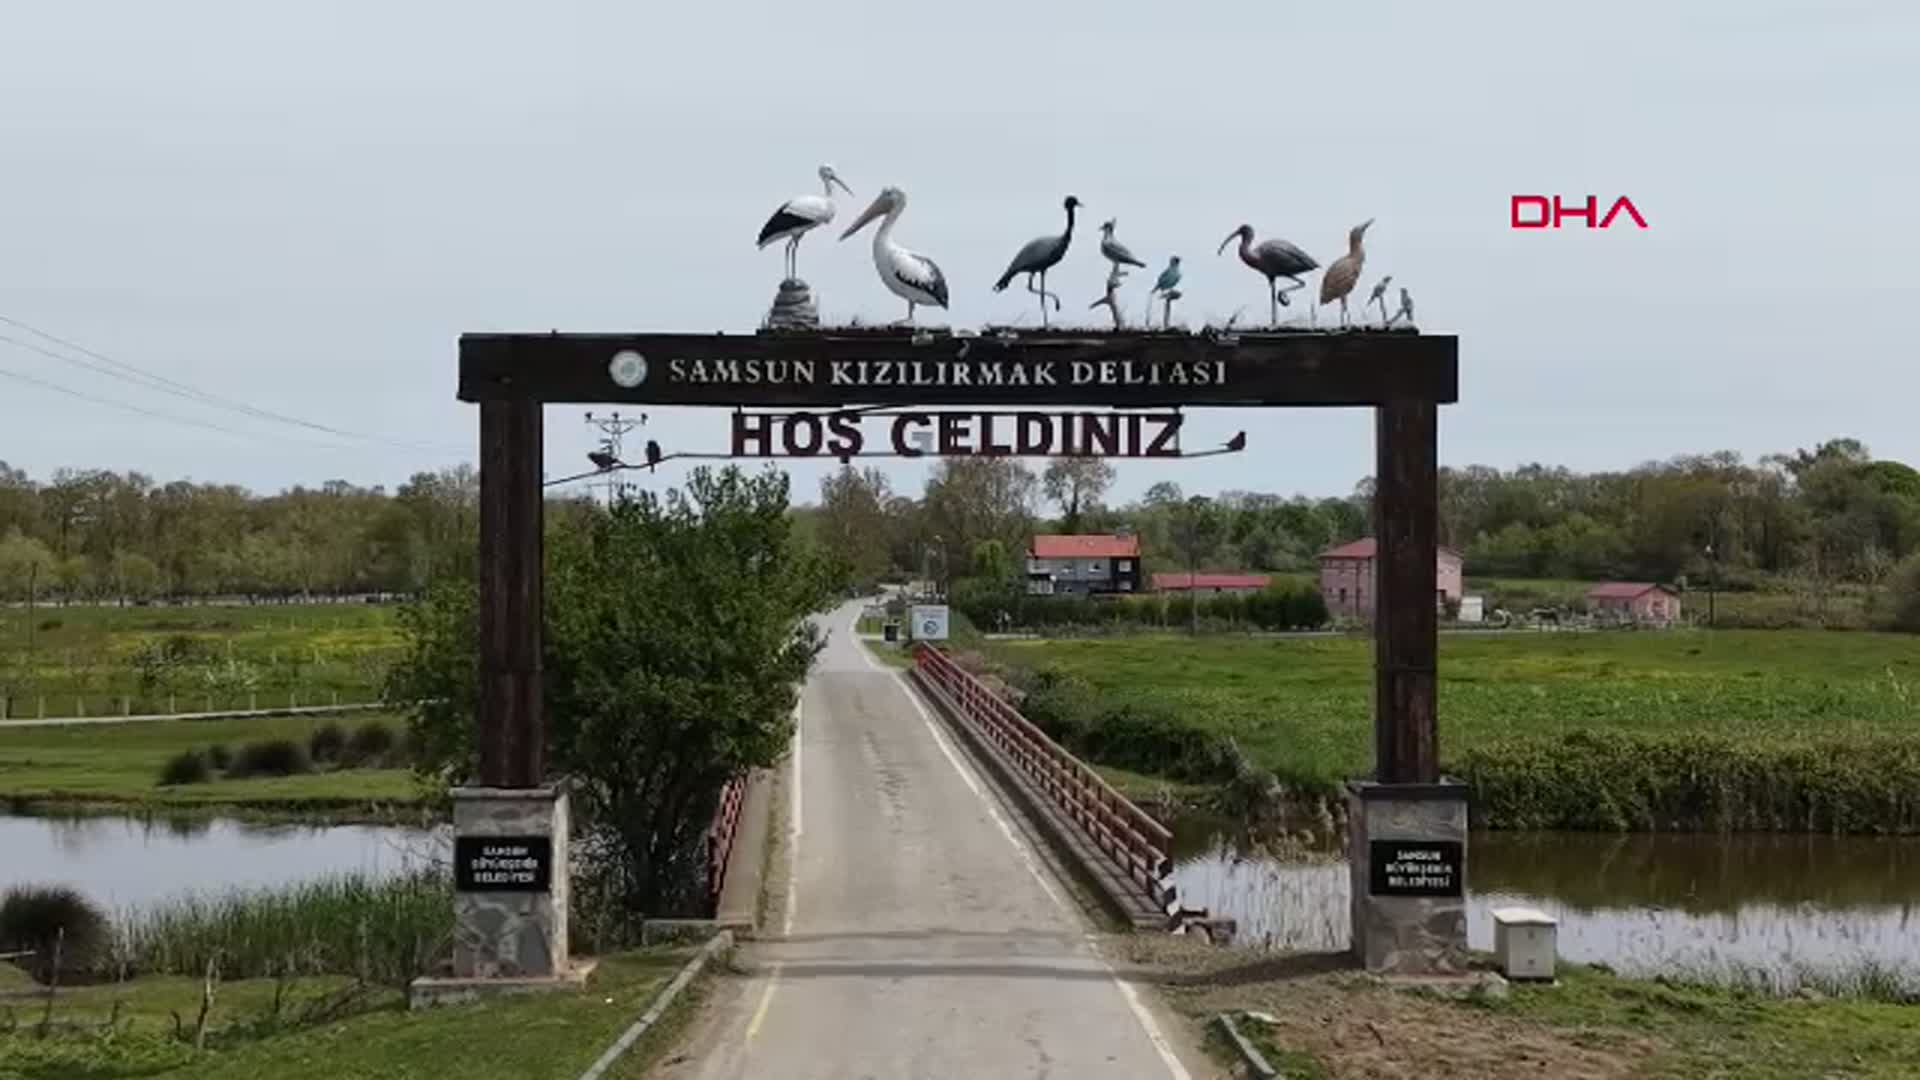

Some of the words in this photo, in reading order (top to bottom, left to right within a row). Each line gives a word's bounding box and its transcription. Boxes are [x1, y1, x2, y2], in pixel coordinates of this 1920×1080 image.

[669, 359, 815, 383] SAMSUN
[830, 361, 1056, 385] KIZILIRMAK
[732, 411, 863, 464] HOŞ
